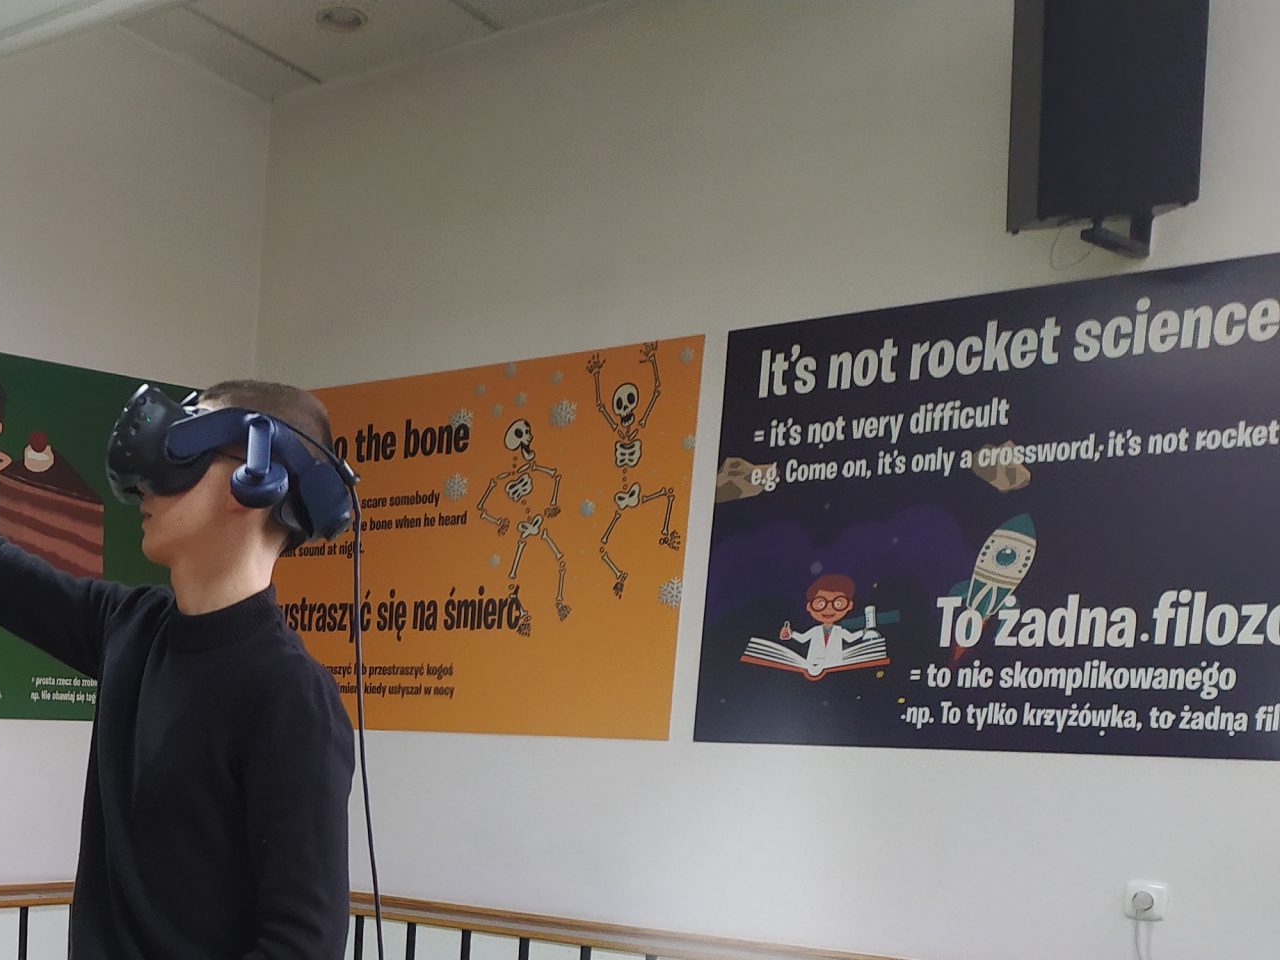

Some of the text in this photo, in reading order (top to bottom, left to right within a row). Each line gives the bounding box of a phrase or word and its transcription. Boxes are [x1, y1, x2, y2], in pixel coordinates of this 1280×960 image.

[758, 296, 1280, 399] It's not rocket science
[769, 396, 1010, 448] it's not very difficult
[355, 424, 396, 463] the
[404, 419, 470, 459] bone
[751, 420, 1280, 492] e.g. Come on, it's only a crossword, it's not rocket
[361, 490, 440, 509] scare somebody
[370, 517, 392, 531] bone
[395, 515, 421, 529] when
[423, 513, 435, 527] he
[438, 510, 467, 527] heard
[298, 542, 326, 557] sound
[327, 543, 337, 555] at
[376, 589, 407, 641] się
[412, 599, 438, 631] na
[936, 596, 984, 648] To
[994, 594, 1137, 648] żadna
[73, 677, 81, 686] do
[369, 663, 424, 679] przestraszyć
[426, 662, 454, 680] kogoś
[927, 660, 1237, 700] to nic skomplikowanego
[364, 682, 387, 698] kiedy
[388, 683, 422, 698] usłyszał
[424, 686, 432, 695] w
[433, 686, 455, 699] nocy
[906, 706, 934, 729] np.
[940, 701, 962, 724] To
[967, 702, 1018, 731] tylko
[1023, 702, 1142, 733] krzyżówka,
[1150, 707, 1175, 730] to
[1179, 705, 1249, 732] żadna
